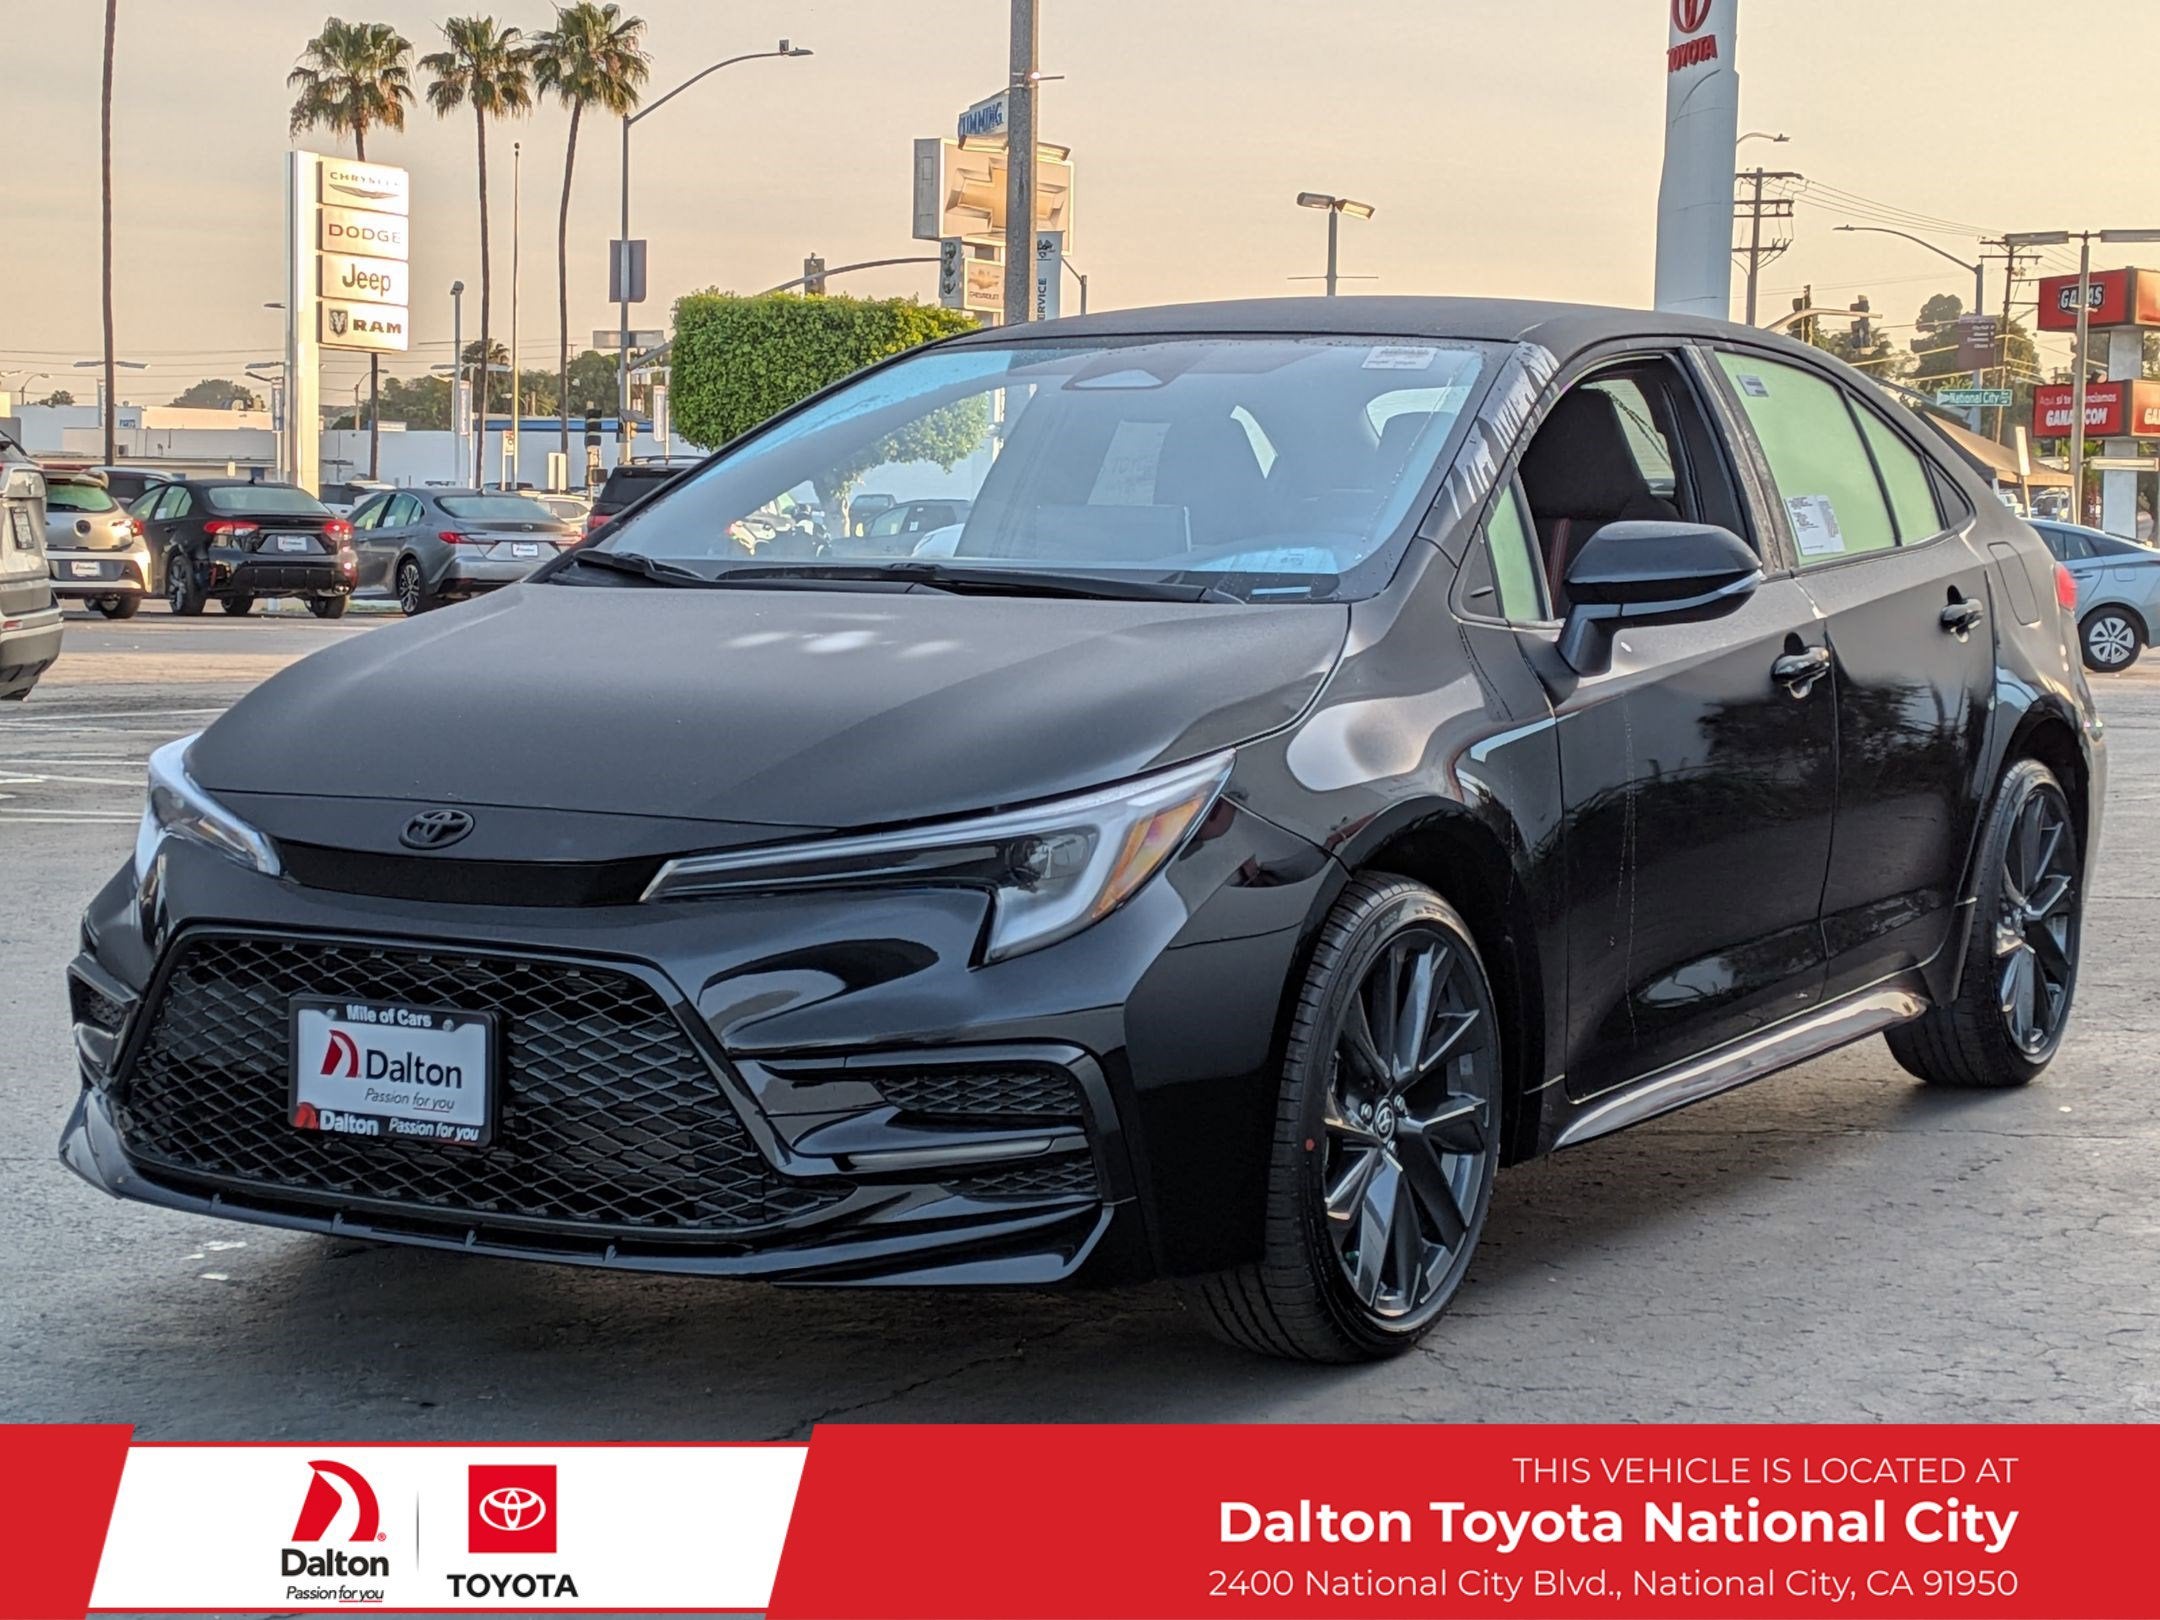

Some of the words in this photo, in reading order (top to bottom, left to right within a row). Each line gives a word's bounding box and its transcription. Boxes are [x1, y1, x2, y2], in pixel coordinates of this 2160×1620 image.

[1667, 34, 1718, 72] TOYOTA
[330, 171, 398, 186] CHRYSL
[328, 223, 400, 244] DODGE
[342, 263, 391, 296] Jeep
[969, 290, 999, 300] CHEVROLET
[1037, 278, 1047, 320] ERVICE
[2060, 286, 2103, 308] GAAS
[353, 318, 401, 334] RAM
[1950, 391, 1982, 404] National
[1983, 391, 1999, 405] City
[2045, 408, 2108, 427] GANACOM
[346, 1004, 376, 1023] Mile
[379, 1008, 395, 1024] of
[397, 1009, 432, 1027] Cars
[366, 1049, 462, 1089] Dalton
[365, 1087, 409, 1104] Passion
[413, 1092, 431, 1107] for
[431, 1096, 455, 1110] you
[319, 1110, 379, 1136] Dalton
[388, 1118, 434, 1136] Passion
[435, 1122, 453, 1139] for
[454, 1128, 479, 1142] you
